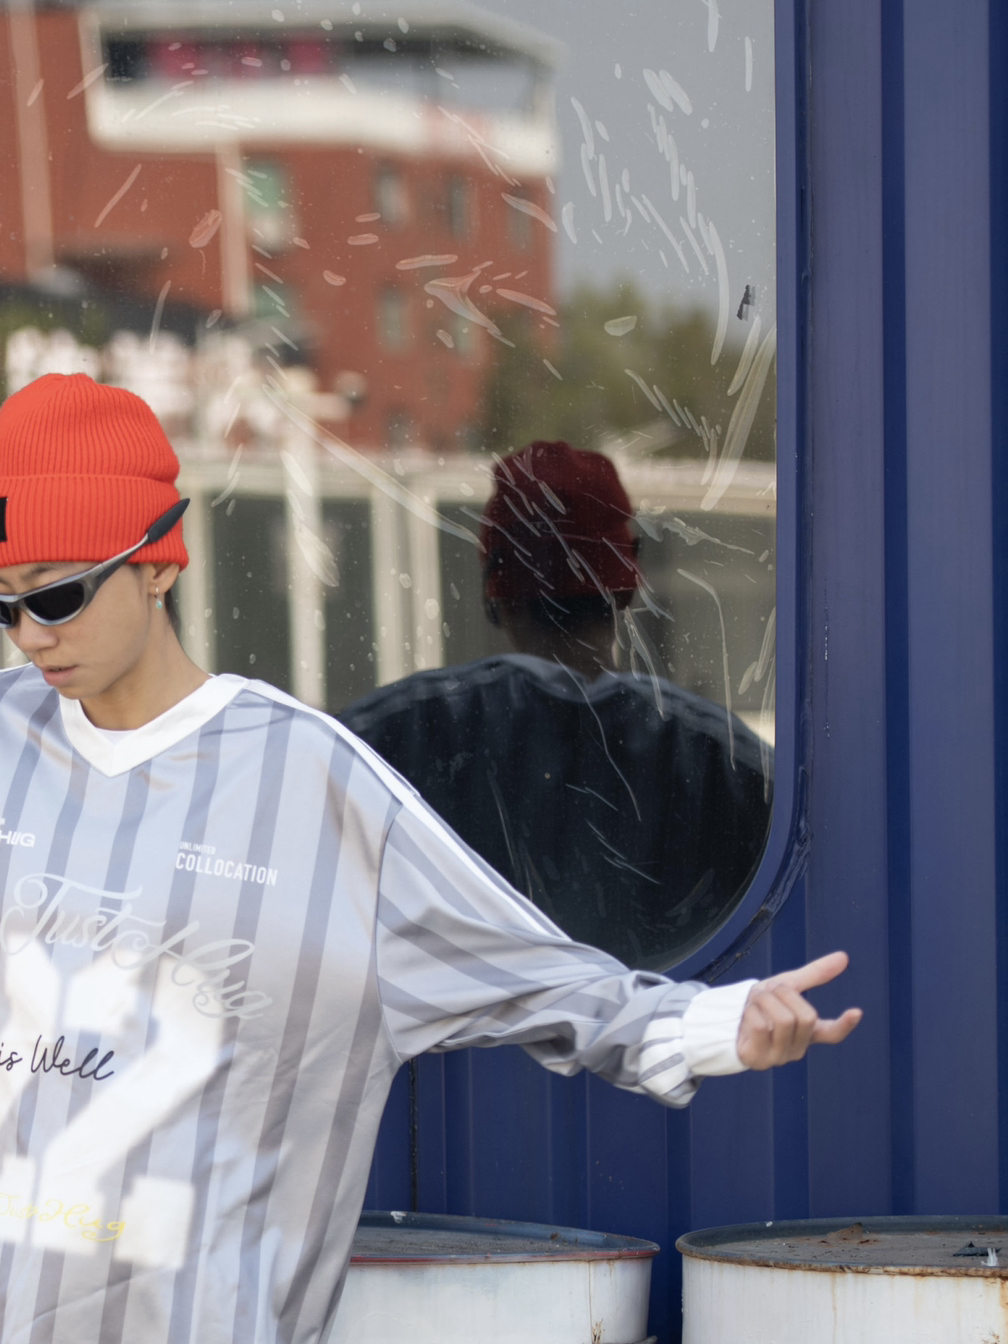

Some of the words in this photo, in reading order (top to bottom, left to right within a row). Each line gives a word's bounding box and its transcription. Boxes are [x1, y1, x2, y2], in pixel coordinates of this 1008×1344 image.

[179, 841, 216, 855] UNLIMITED
[175, 852, 278, 887] COLLOCATION
[30, 1034, 115, 1081] Well
